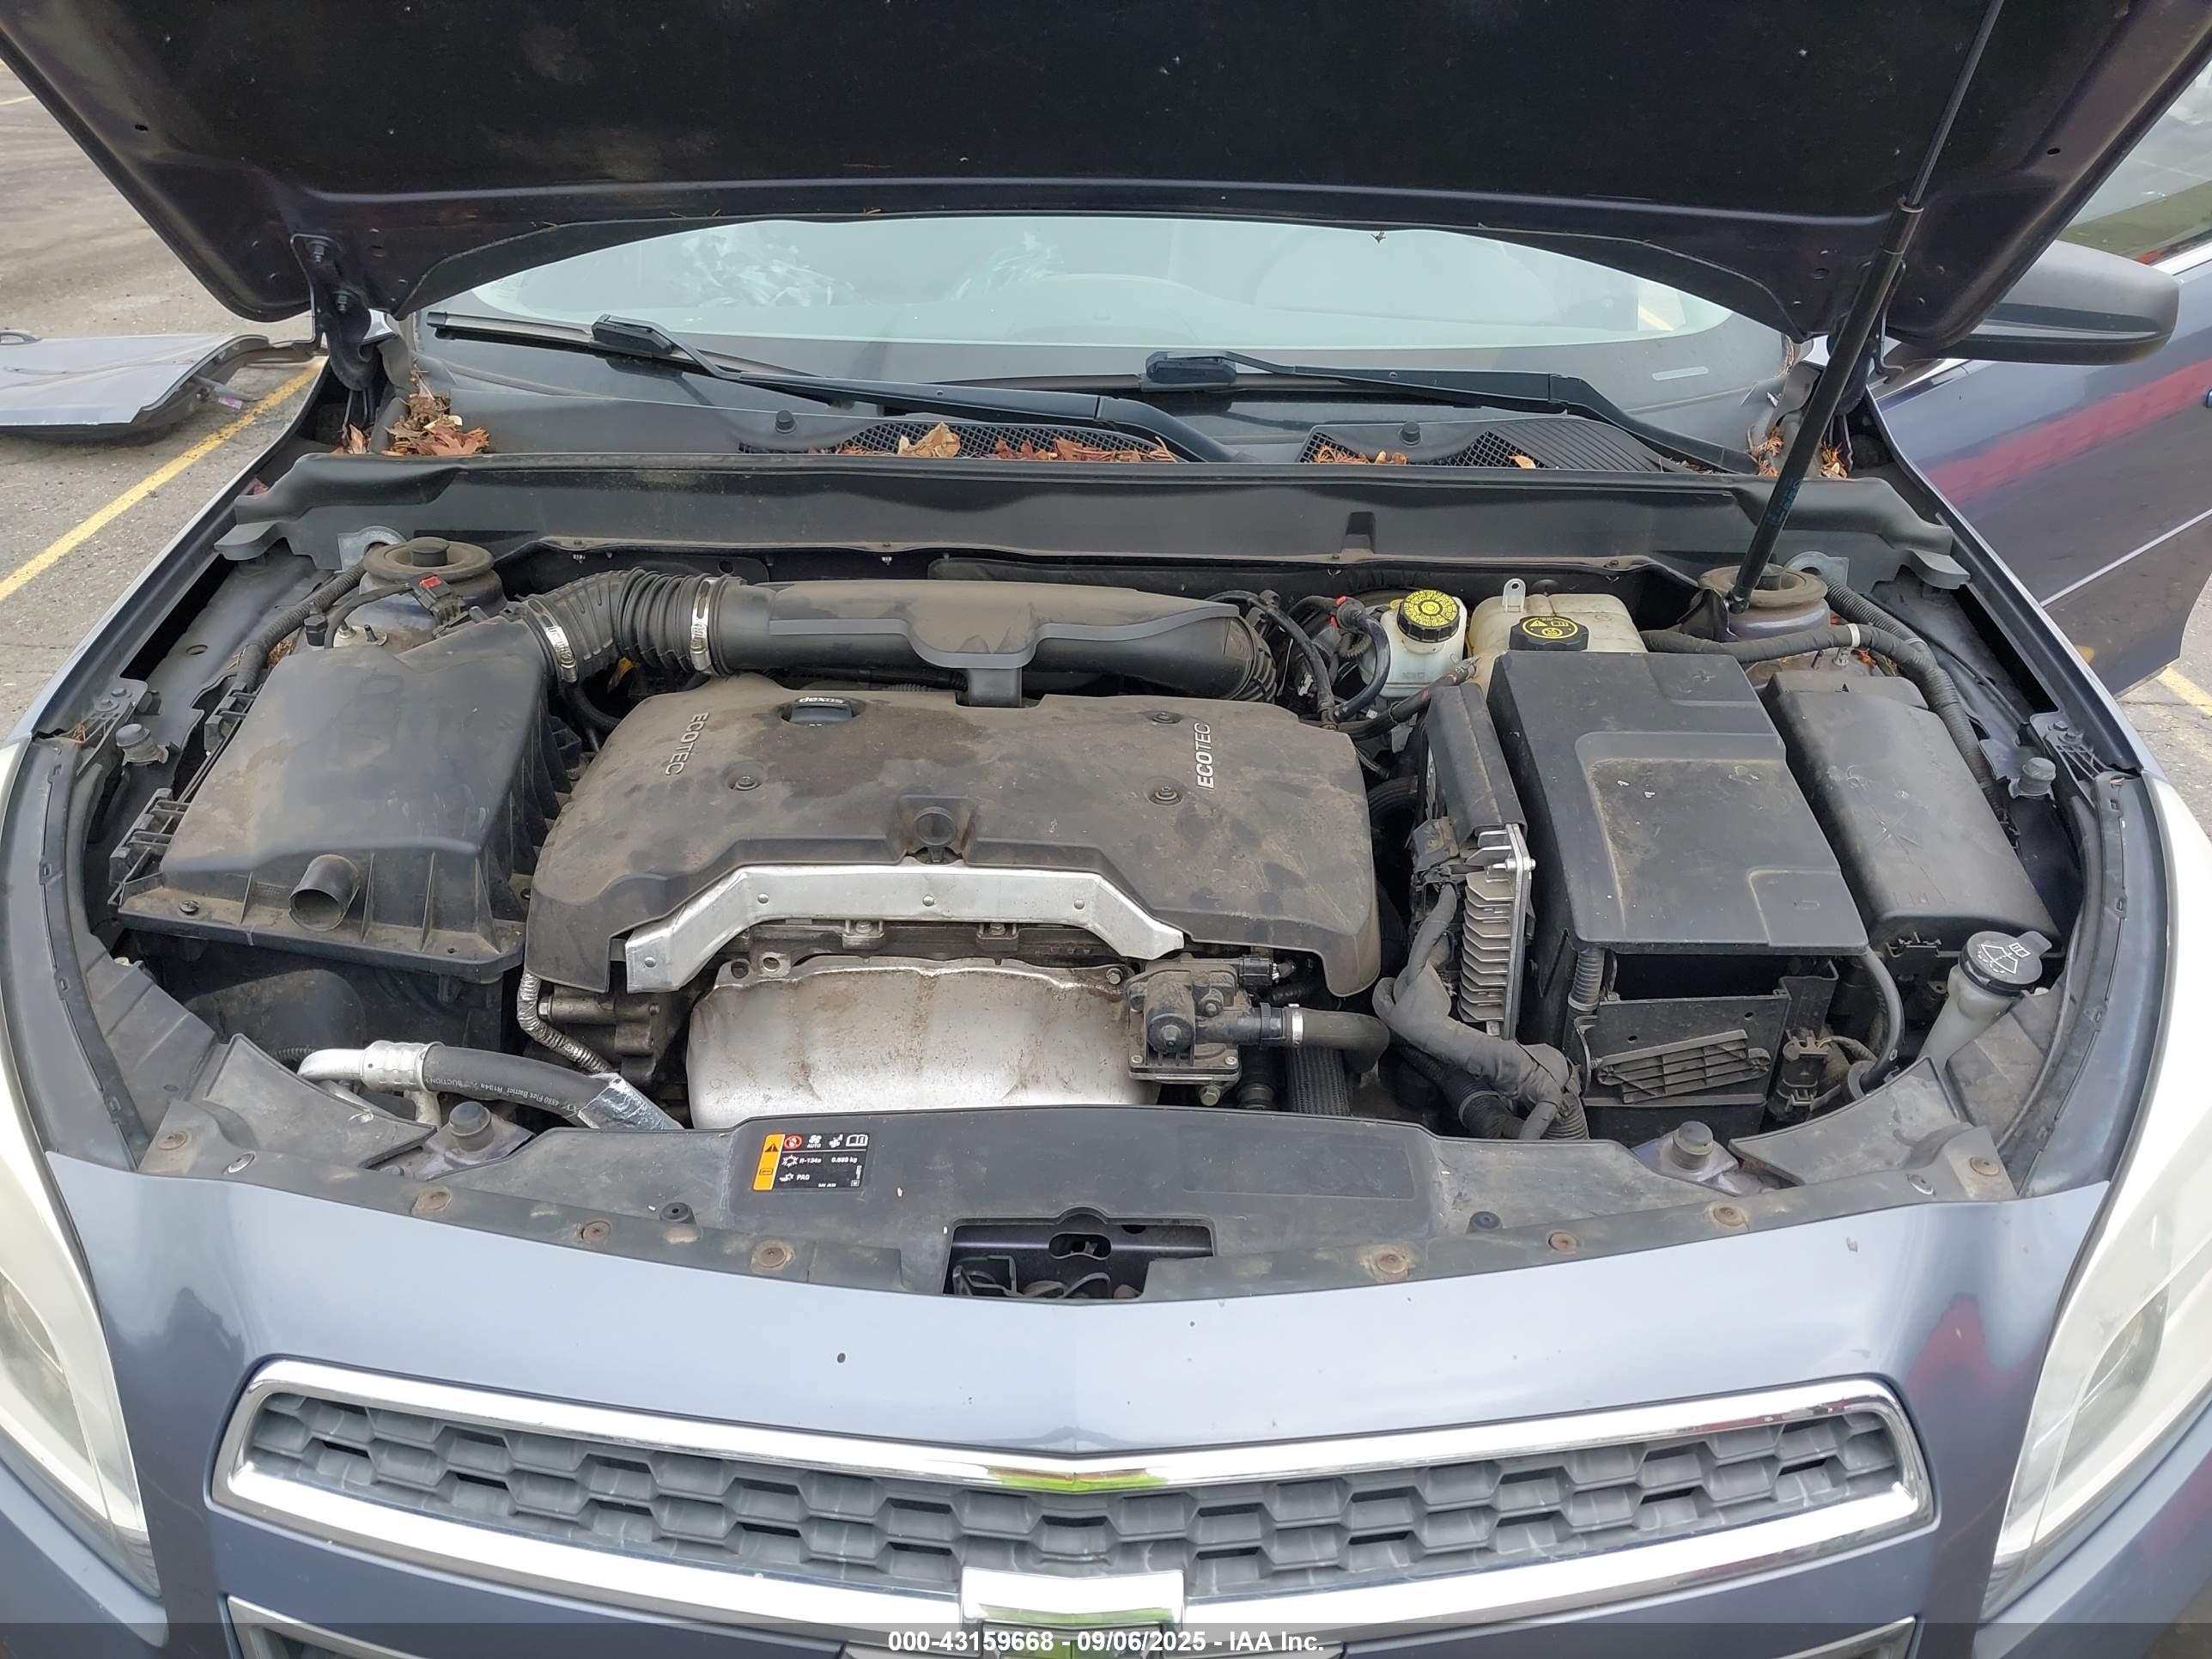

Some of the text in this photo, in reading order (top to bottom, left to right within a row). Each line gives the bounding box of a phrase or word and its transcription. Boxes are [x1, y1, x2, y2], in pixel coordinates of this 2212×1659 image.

[665, 712, 709, 775] ECOTEC
[1194, 722, 1214, 788] ECOTEC
[480, 1083, 503, 1093] R134a
[507, 1087, 529, 1099] Barrier
[529, 1092, 544, 1103] Flex
